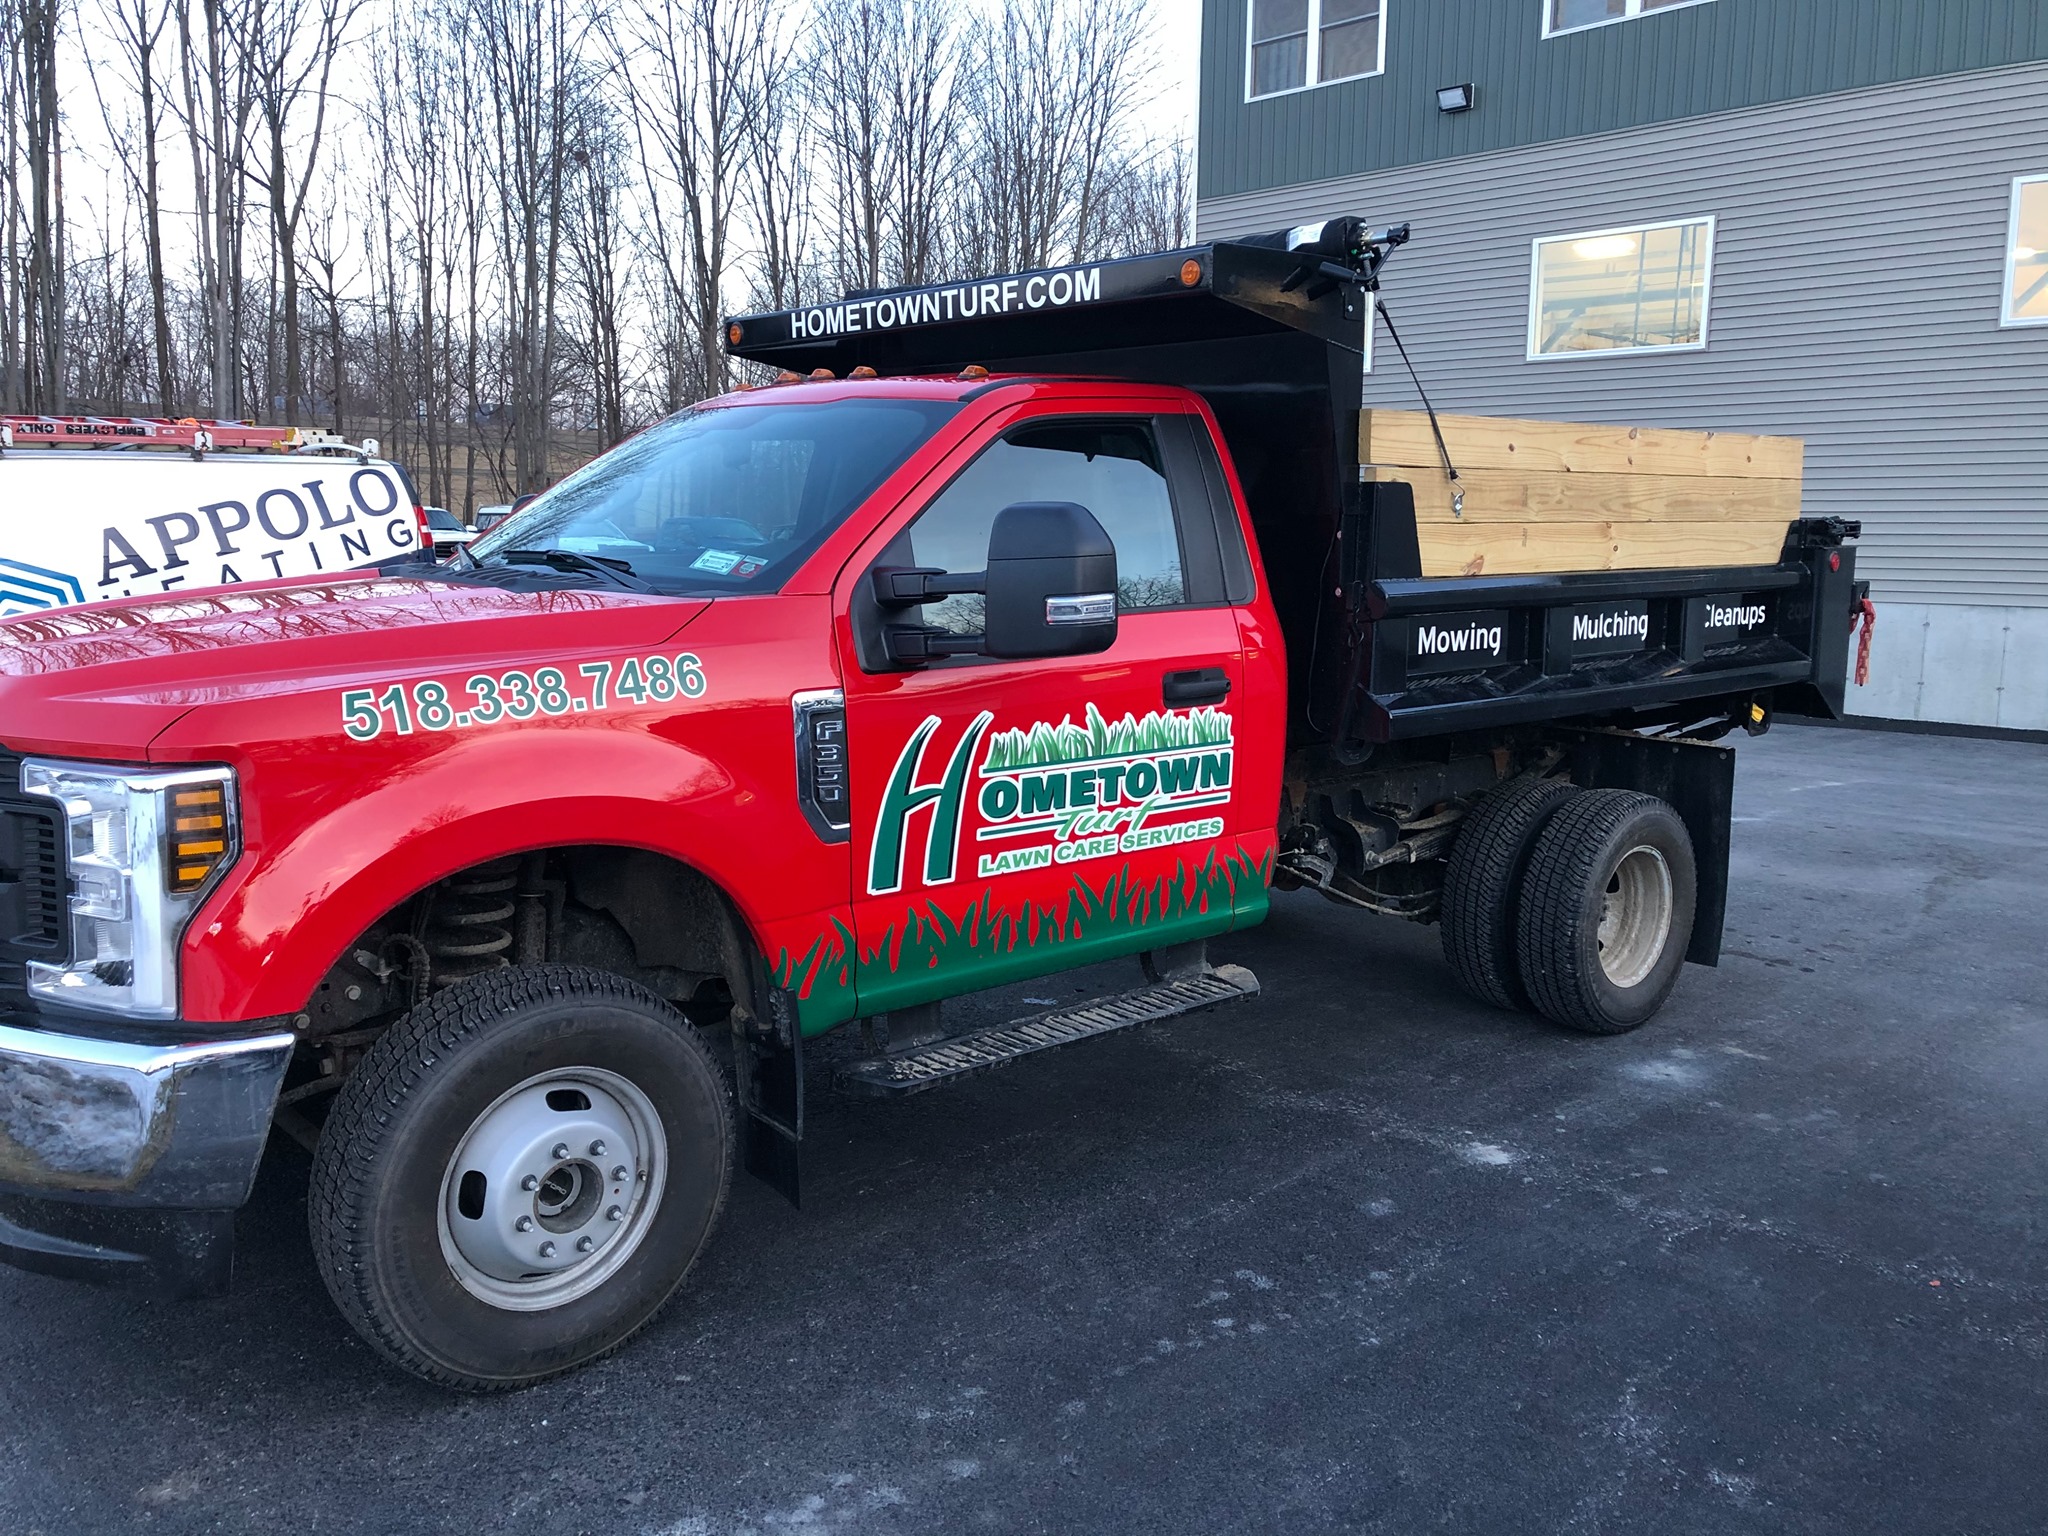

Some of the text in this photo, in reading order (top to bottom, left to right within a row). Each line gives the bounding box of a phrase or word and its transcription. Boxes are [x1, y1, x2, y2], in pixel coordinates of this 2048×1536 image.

[790, 267, 1102, 338] HOMETOWNTURF.COM
[16, 423, 146, 437] EMPLOYEES ONLY
[98, 468, 399, 587] APPOLO
[103, 519, 413, 599] ATING
[1417, 621, 1502, 656] Mowing
[1572, 599, 1649, 642] Mulching
[341, 652, 708, 741] 518.338.7486
[1056, 796, 1166, 840] Turf
[980, 820, 1223, 875] LAWN CARE SERVICES
